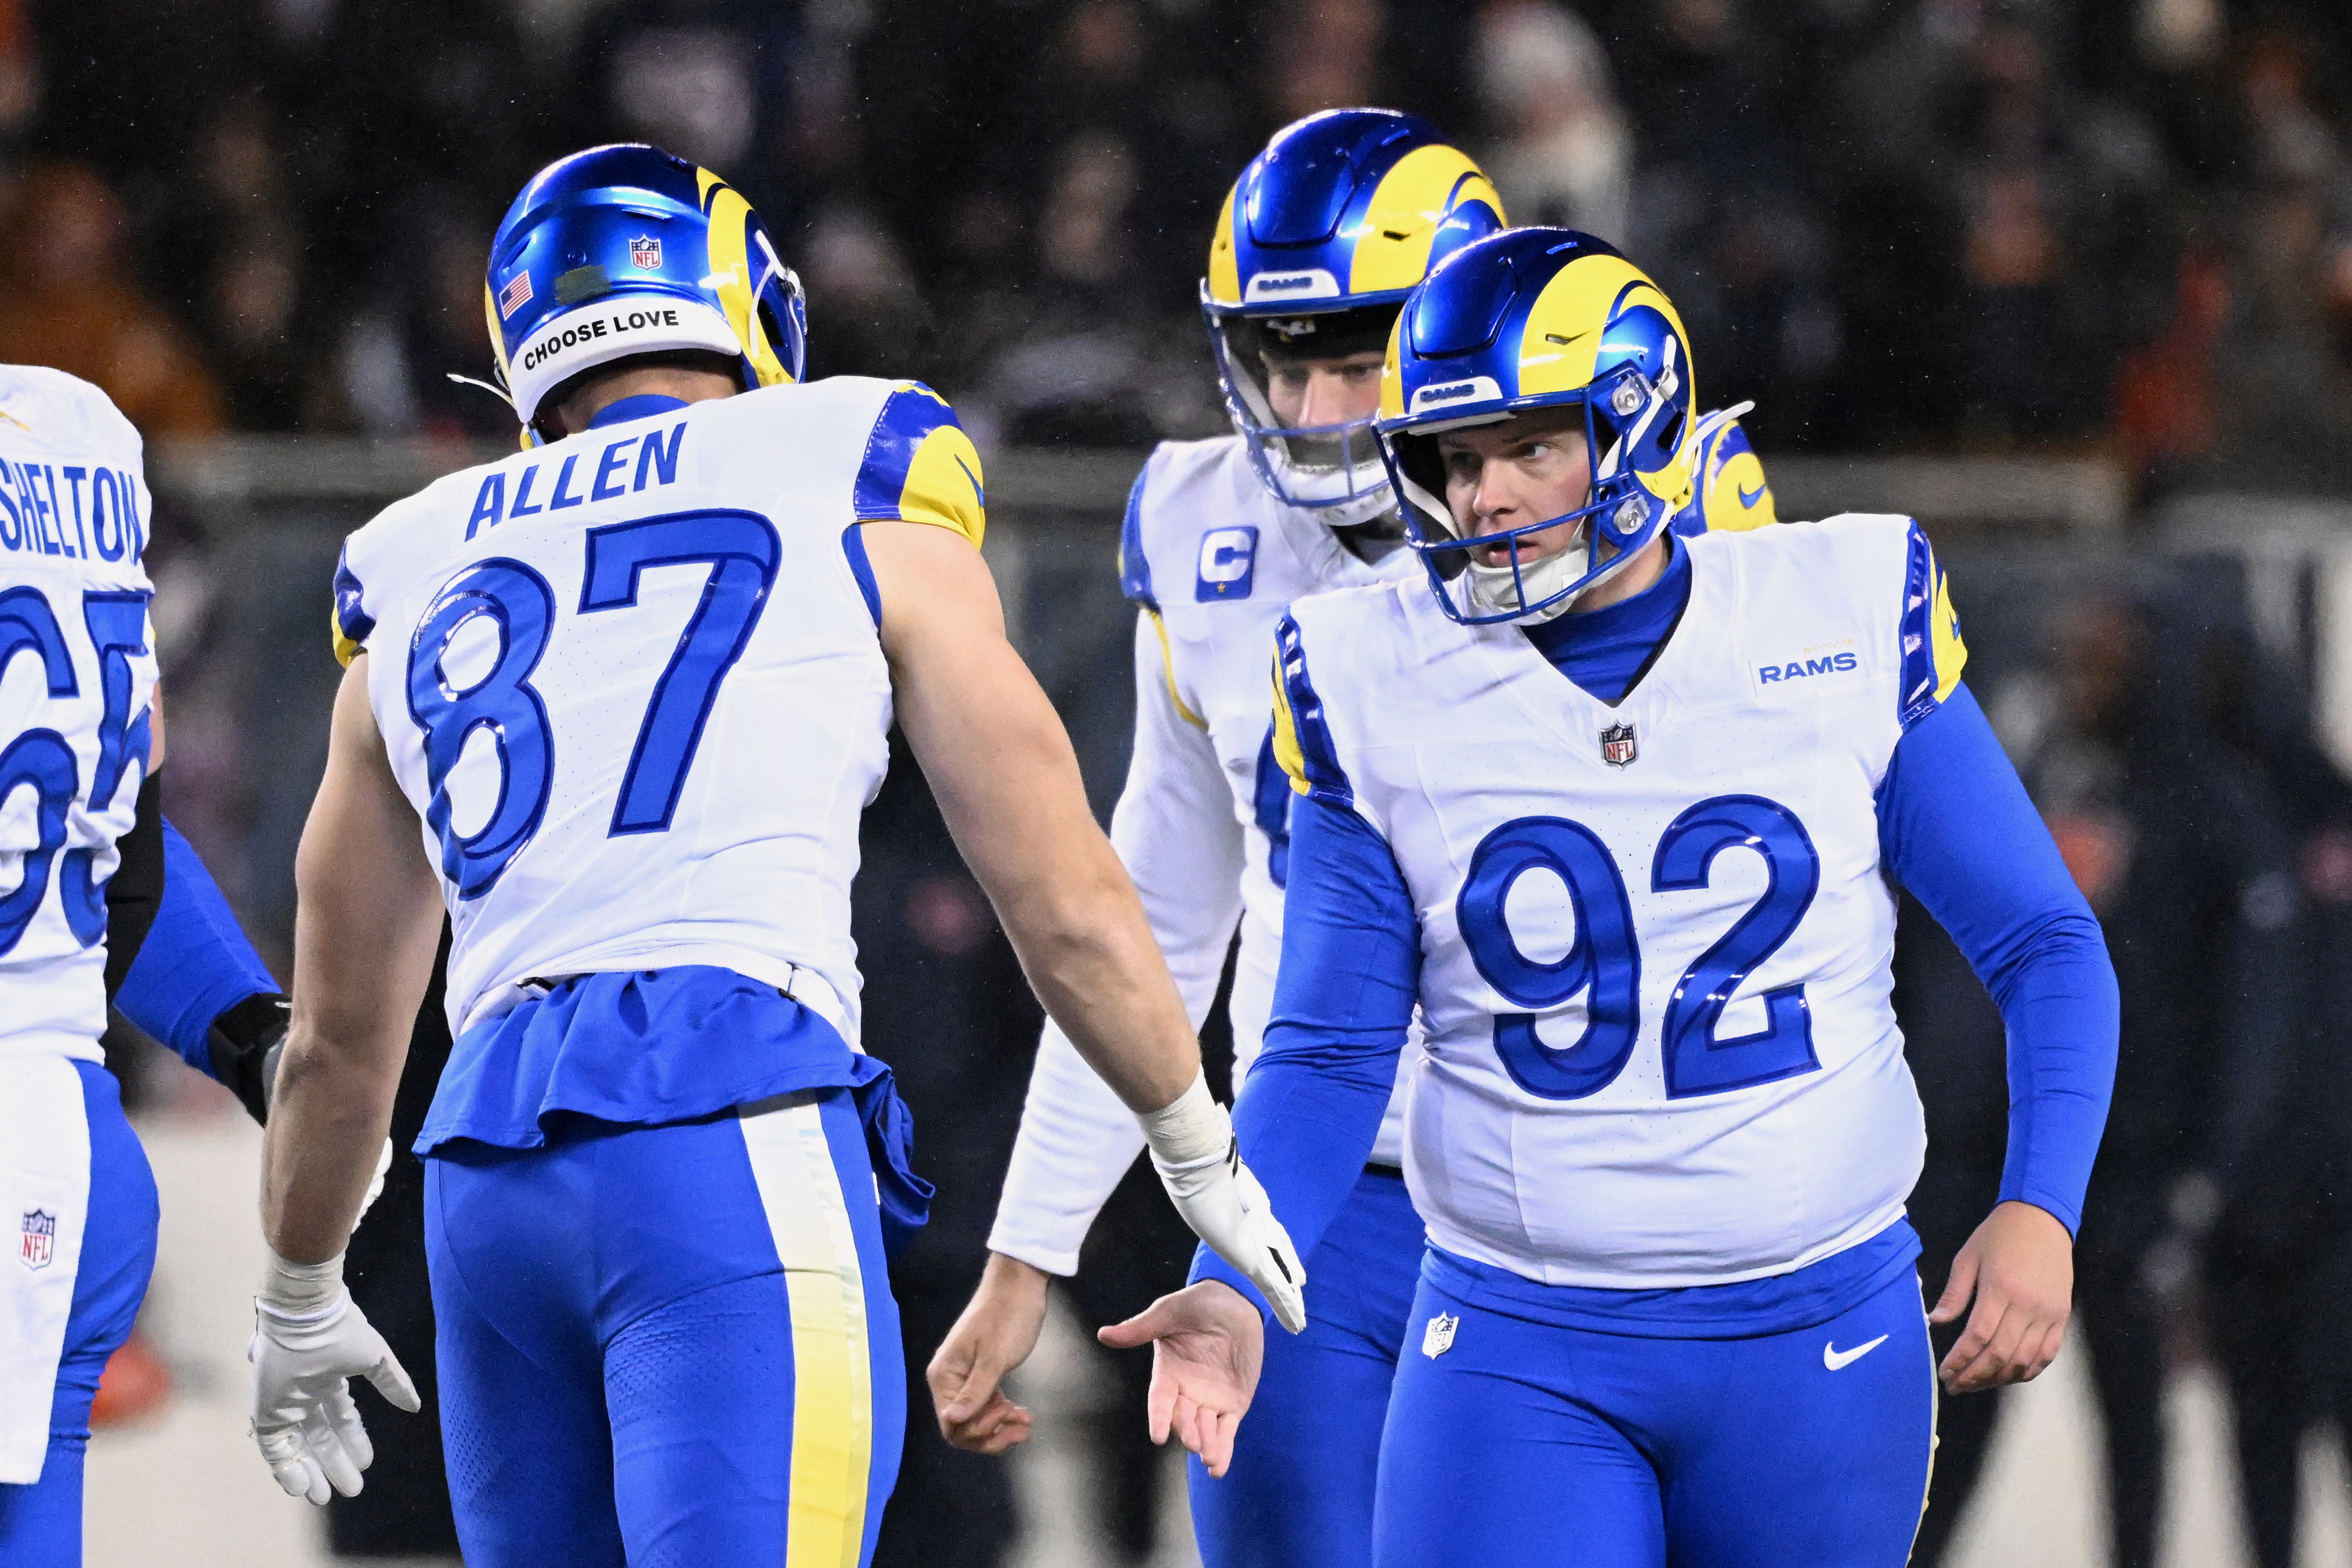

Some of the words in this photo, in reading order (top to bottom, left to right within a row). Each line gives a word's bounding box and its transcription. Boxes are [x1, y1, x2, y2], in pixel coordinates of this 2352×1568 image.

[635, 252, 658, 267] NFL
[524, 320, 607, 370] CHOOSE
[613, 310, 679, 332] LOVE
[1420, 383, 1476, 403] RAMS
[464, 421, 688, 542] ALLEN
[0, 457, 143, 566] SHELTON
[1200, 530, 1250, 582] C
[1758, 653, 1857, 685] RAMS
[405, 508, 783, 901] 87
[1606, 742, 1633, 761] NFL
[1456, 794, 1822, 1101] 92
[22, 1234, 48, 1262] NFL
